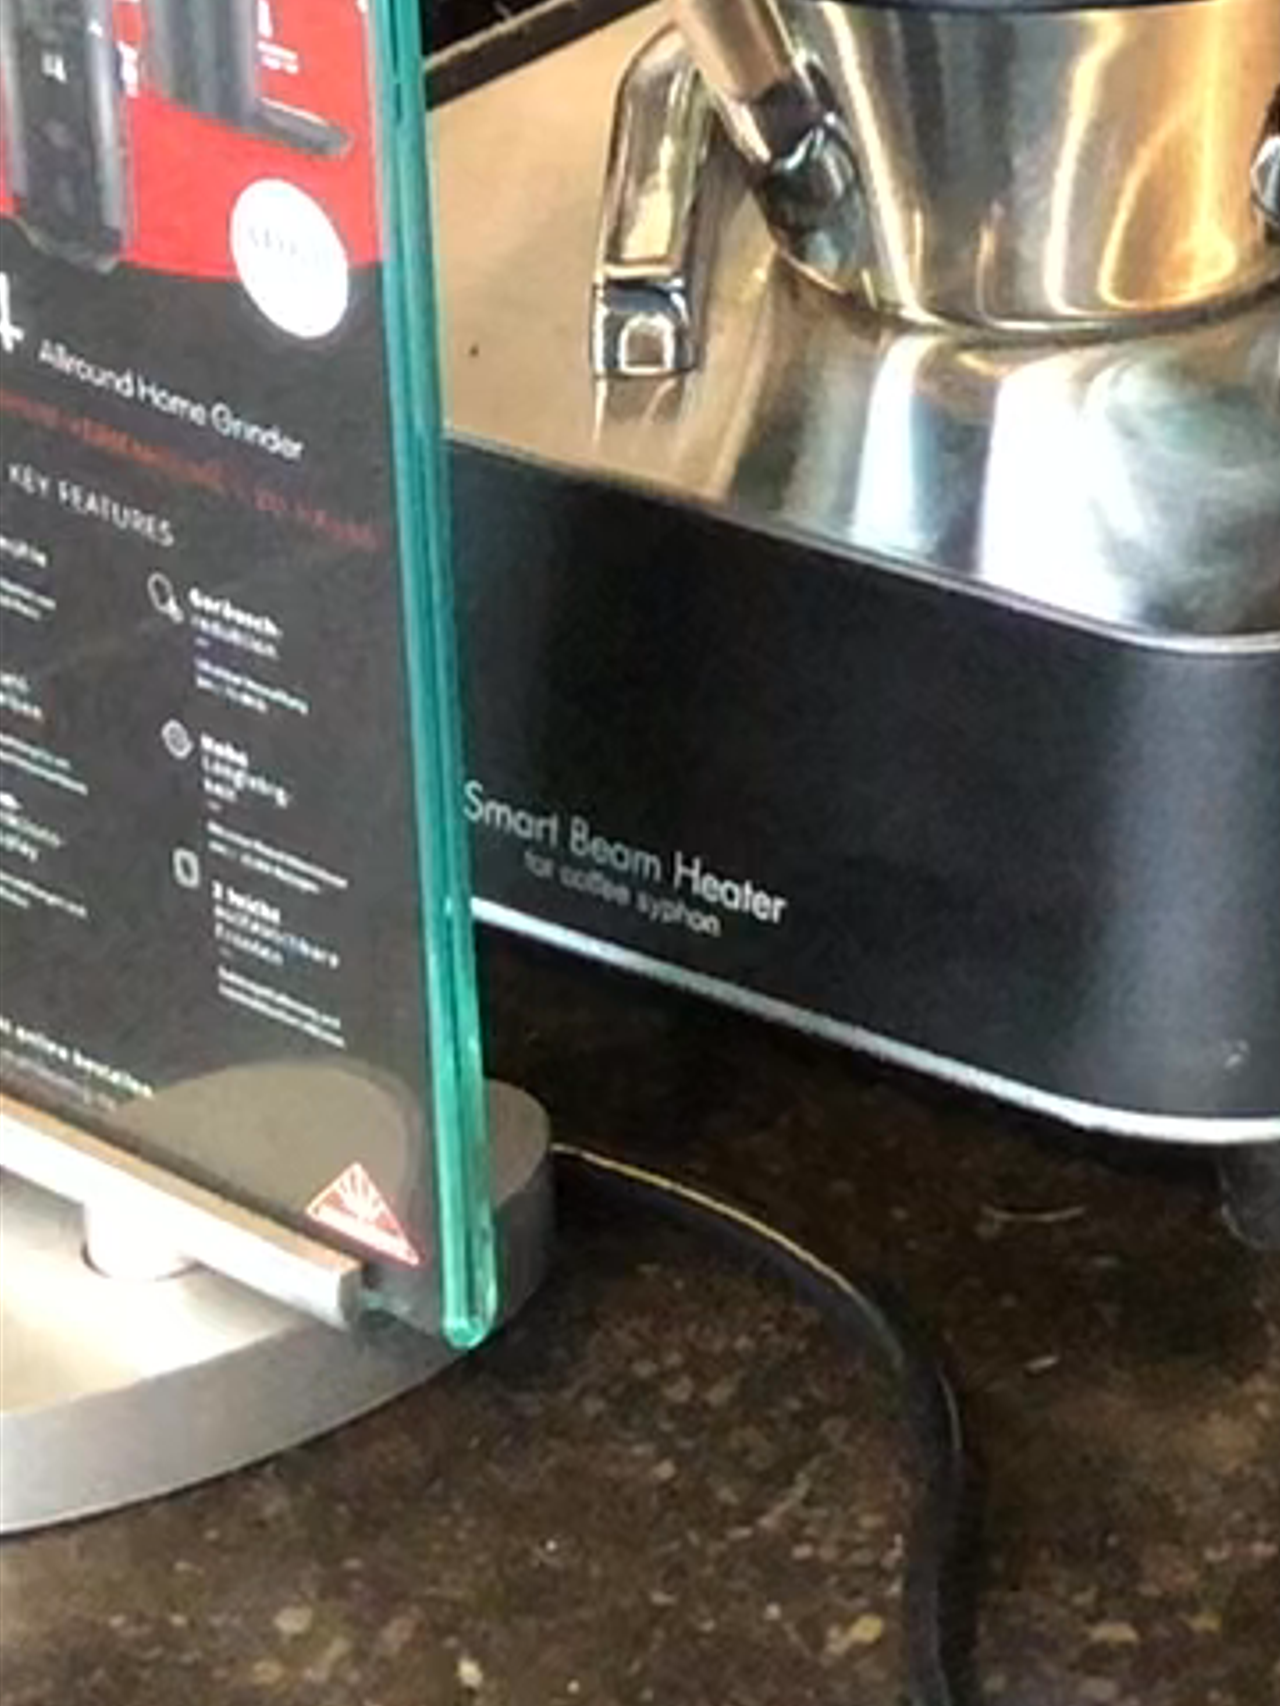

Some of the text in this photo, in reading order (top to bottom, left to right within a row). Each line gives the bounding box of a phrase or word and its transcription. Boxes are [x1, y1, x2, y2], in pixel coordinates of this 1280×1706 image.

[38, 339, 135, 399] Allround
[136, 374, 206, 427] Home
[210, 401, 305, 461] Grinder
[8, 462, 175, 548] KEY FEATURES
[463, 780, 788, 925] Smart Beam Heater
[523, 850, 722, 938] for coffee syphon
